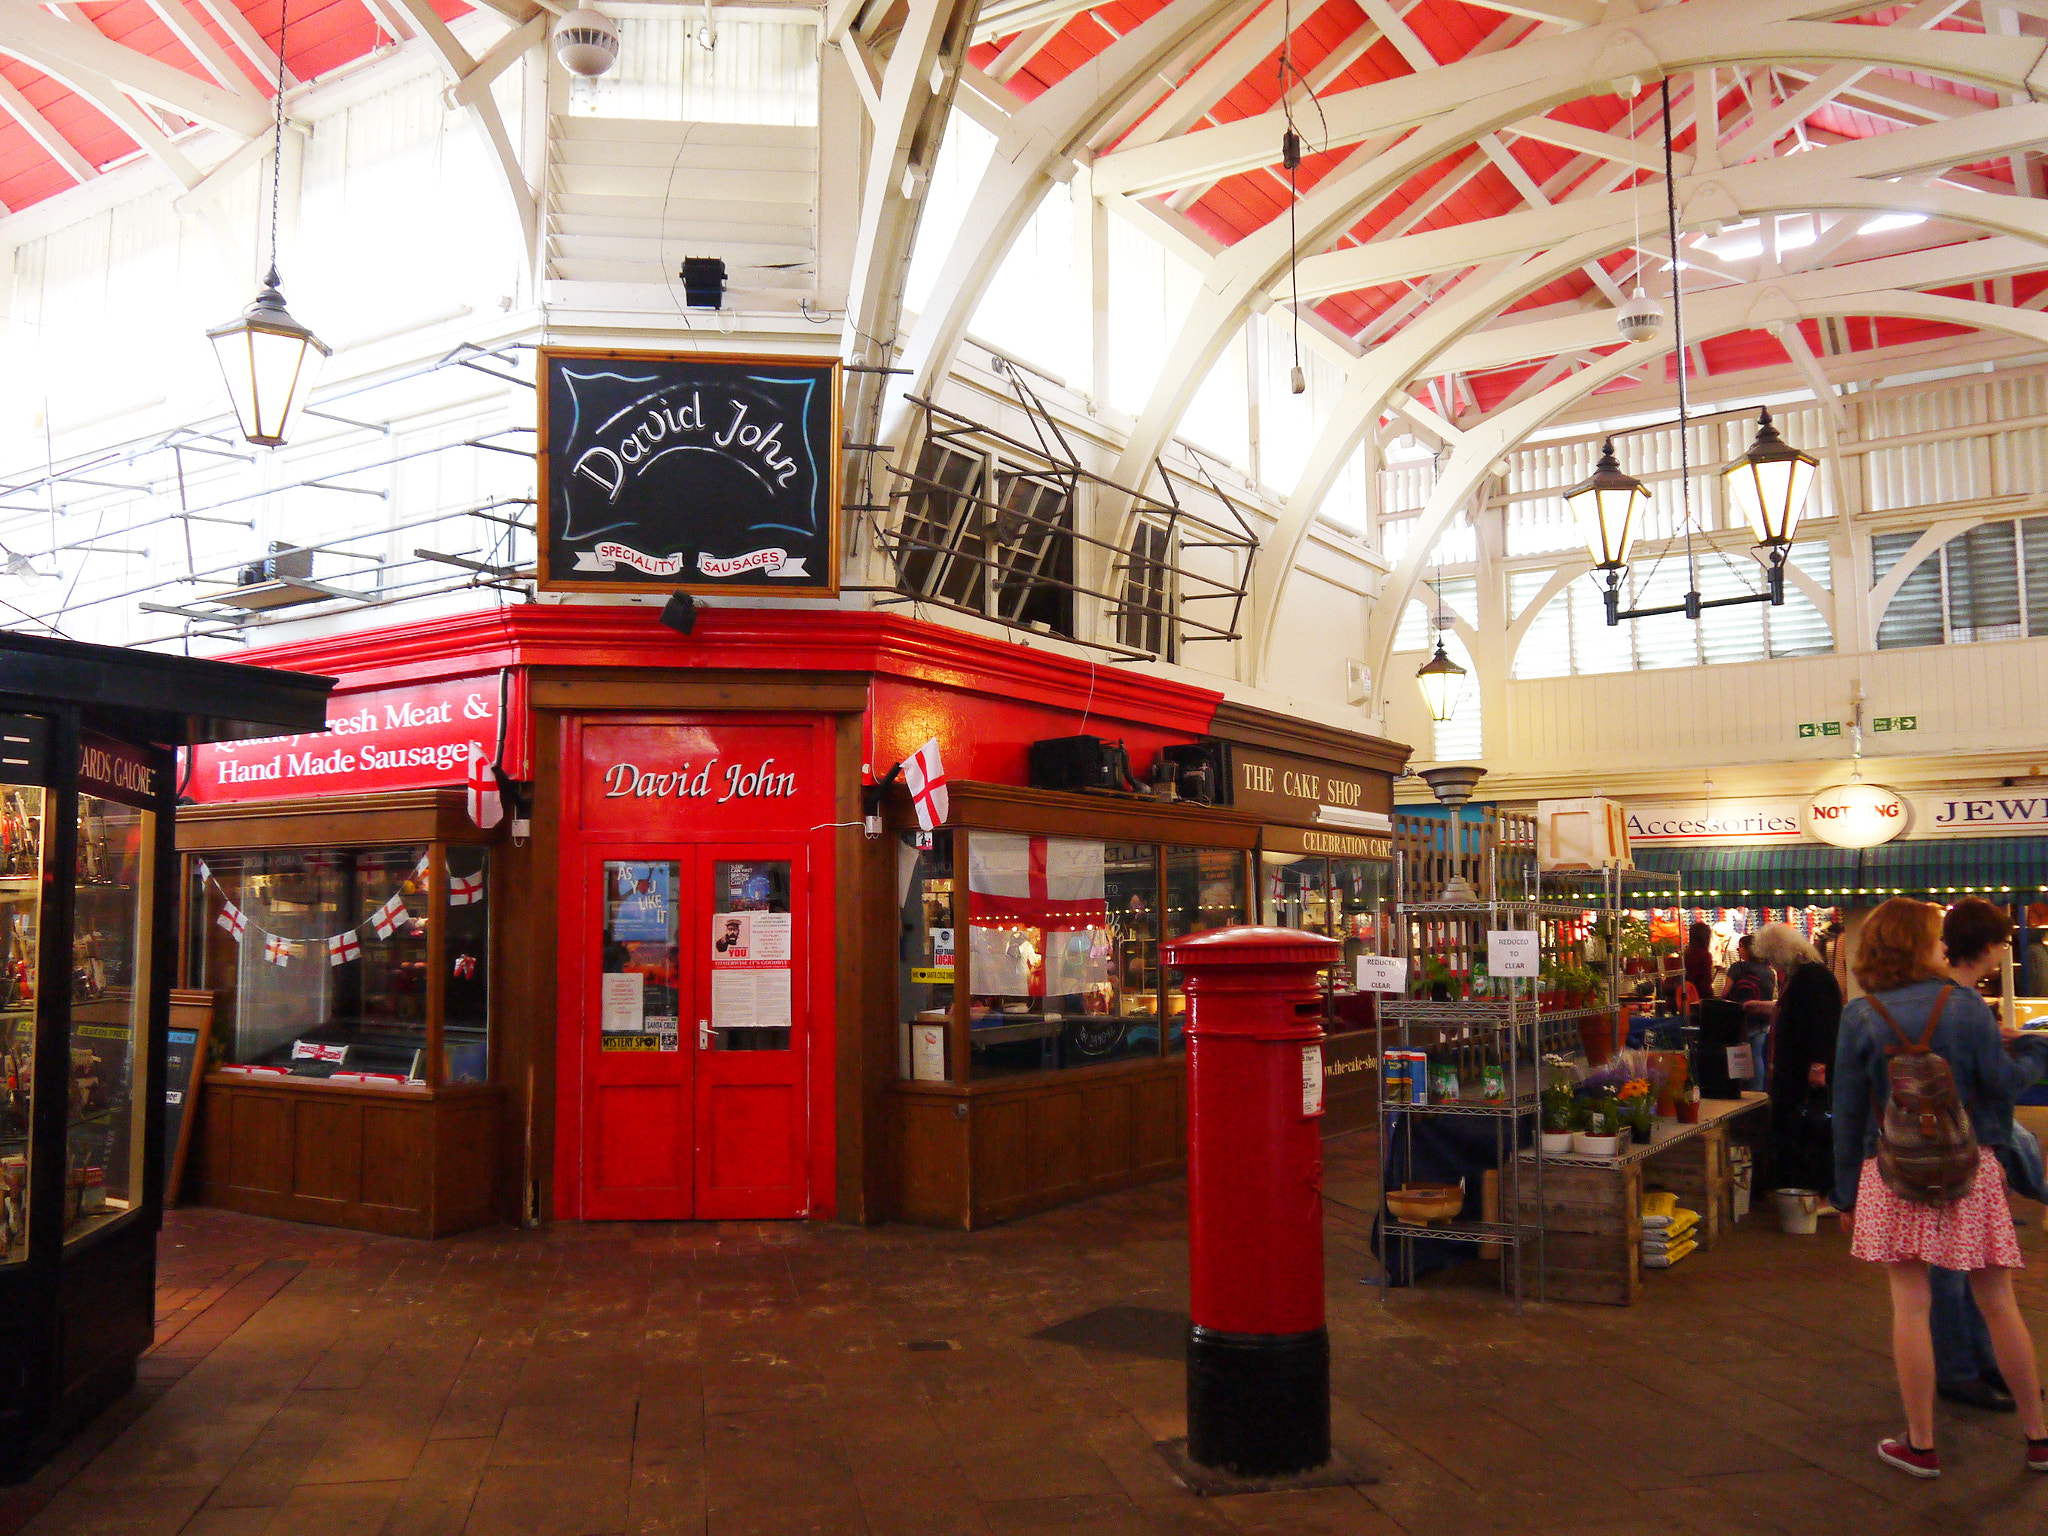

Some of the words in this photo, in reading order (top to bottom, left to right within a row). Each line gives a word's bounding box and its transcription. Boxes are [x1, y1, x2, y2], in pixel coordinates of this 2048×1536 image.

[572, 391, 706, 504] David
[712, 399, 798, 489] John
[600, 545, 677, 573] SPECIALITY
[702, 551, 780, 573] SAUSAGES
[309, 708, 379, 742] resh
[384, 700, 453, 731] Meat
[463, 692, 493, 720] &
[79, 744, 112, 784] ARDS
[114, 757, 156, 797] GALORE
[217, 759, 283, 785] Hand
[287, 749, 356, 778] Made
[360, 740, 482, 771] Sausage
[604, 758, 718, 799] David
[717, 758, 798, 805] John
[1242, 763, 1275, 793] THE
[1283, 770, 1320, 800] CAKE
[1327, 779, 1362, 807] SHOP
[1627, 812, 1797, 836] Accessories
[1303, 831, 1369, 856] CELEBRATION
[617, 866, 634, 881] AS
[638, 894, 662, 911] LIKE
[656, 909, 668, 924] IT
[1498, 938, 1530, 946] REDUCED
[728, 949, 747, 958] YOU
[1509, 950, 1520, 958] TO
[1367, 958, 1397, 967] REDUCED
[1504, 962, 1526, 970] CLEAR
[1376, 970, 1386, 978] TO
[1370, 981, 1391, 990] CLEAR
[602, 1037, 634, 1048] MYSTERY
